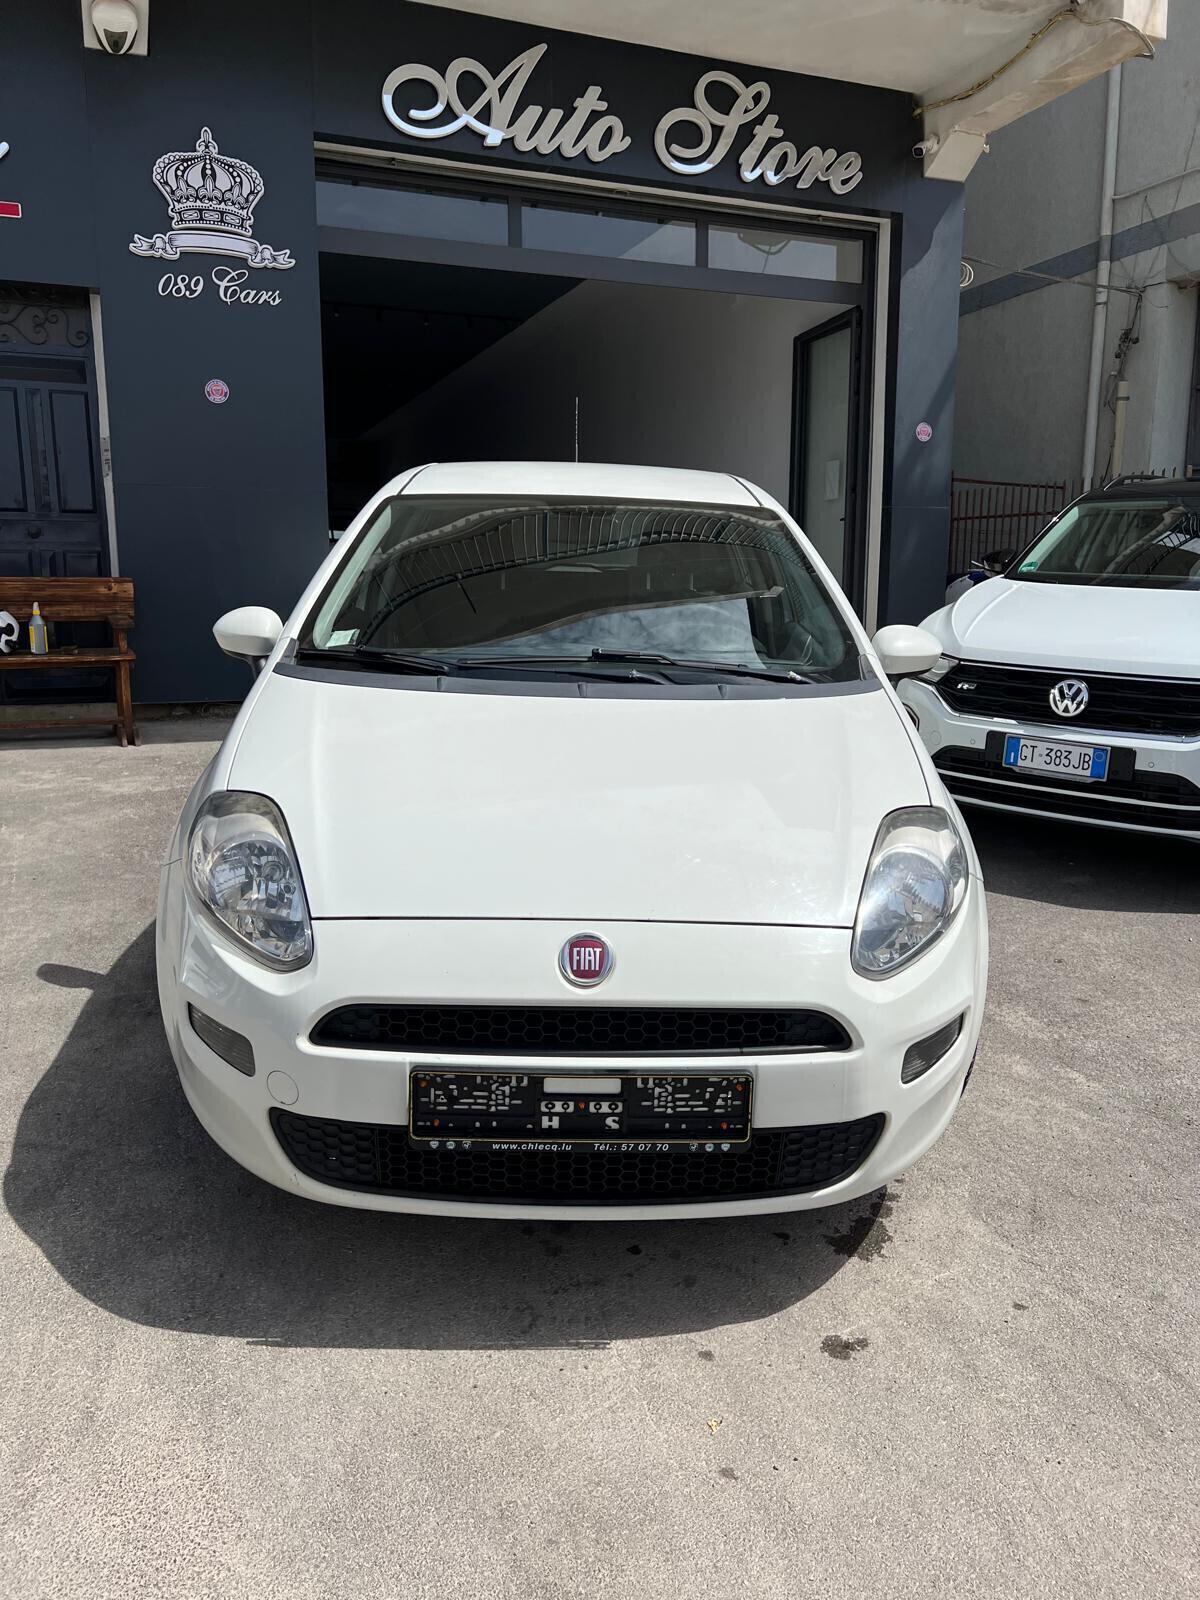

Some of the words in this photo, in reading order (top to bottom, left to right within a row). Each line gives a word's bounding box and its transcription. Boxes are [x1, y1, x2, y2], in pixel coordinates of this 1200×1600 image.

[381, 43, 631, 163] Auto
[654, 70, 864, 195] Store
[158, 273, 204, 298] 089
[211, 266, 282, 305] Cars
[572, 947, 603, 971] FIAT
[491, 1142, 573, 1151] www.chlecq.lu
